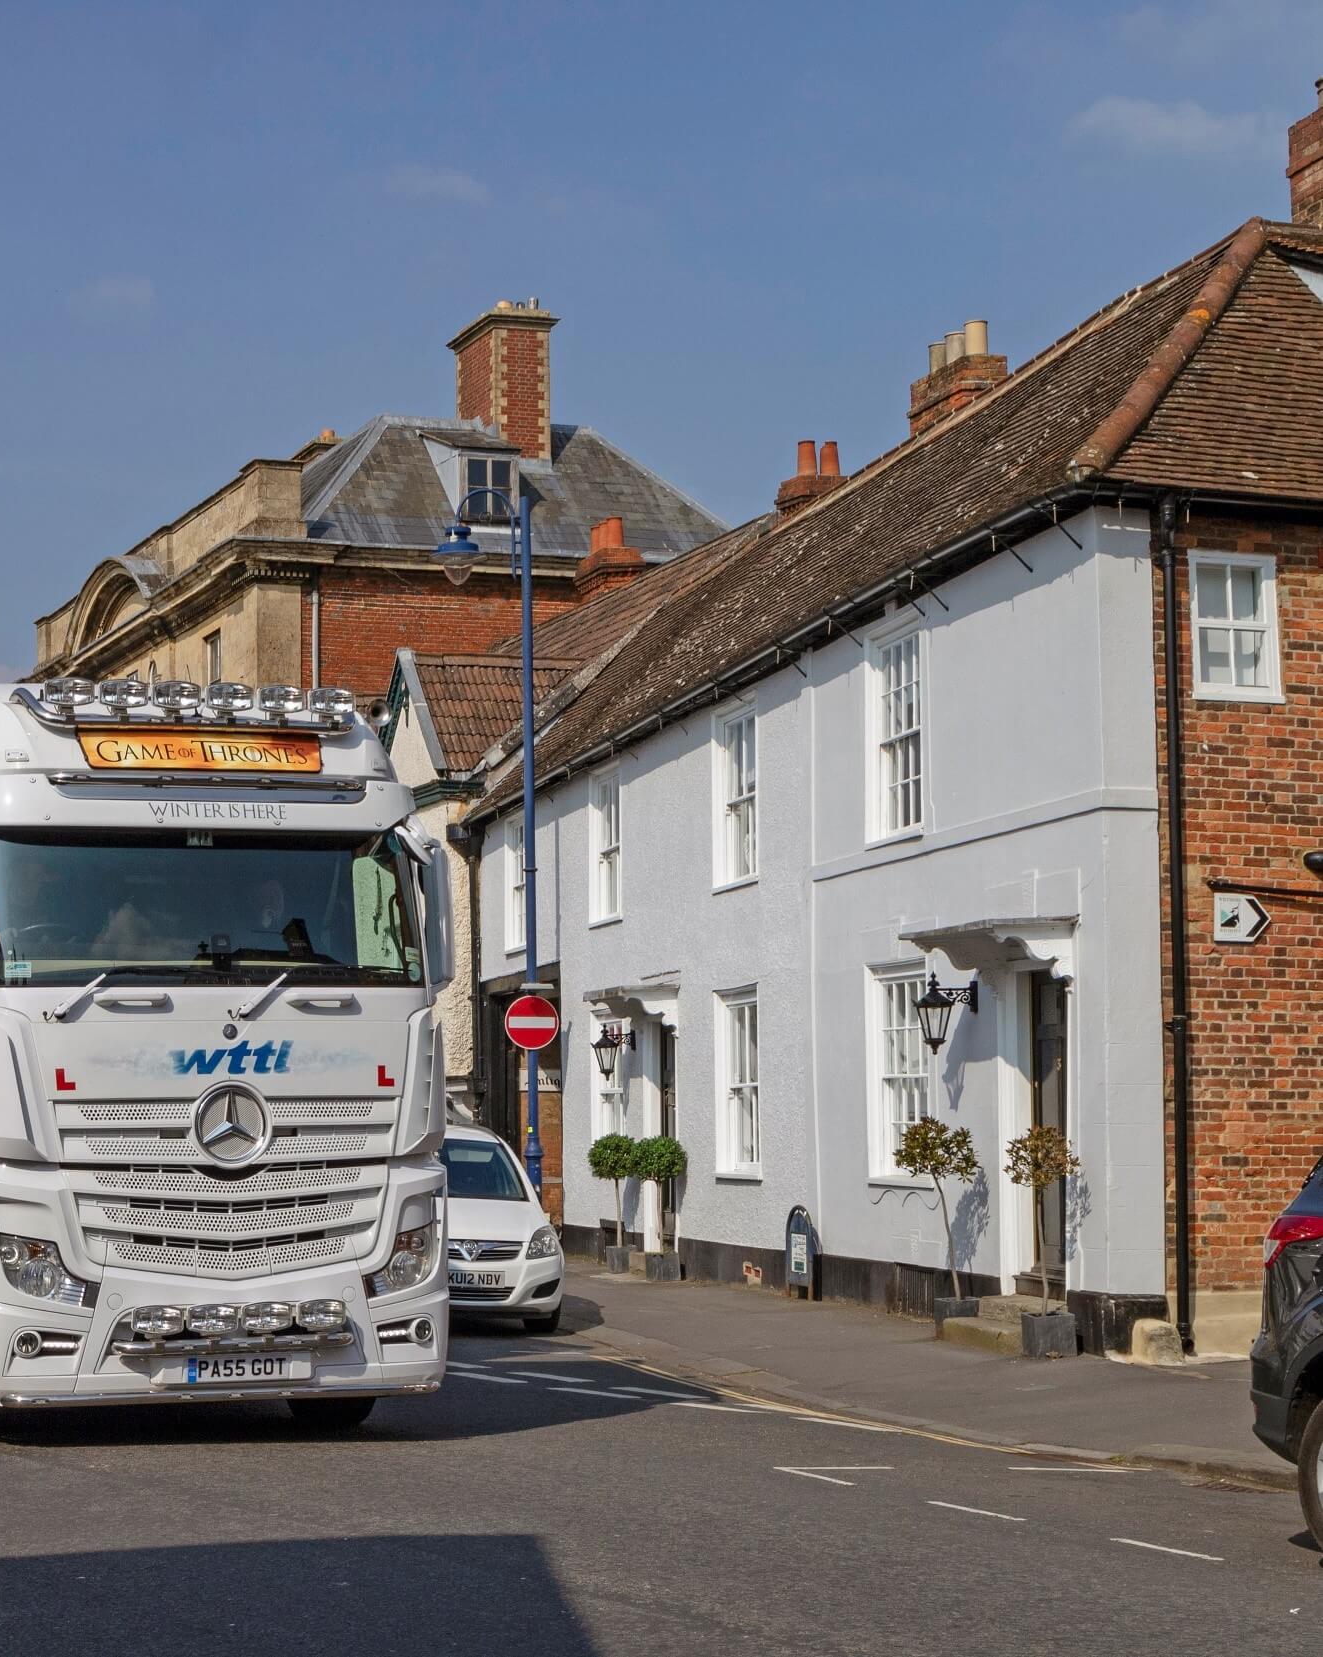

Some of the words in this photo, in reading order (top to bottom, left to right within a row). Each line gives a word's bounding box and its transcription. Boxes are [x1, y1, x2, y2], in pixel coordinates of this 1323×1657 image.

[96, 739, 176, 764] GAME
[178, 746, 196, 758] OF
[191, 739, 308, 766] THRONES
[148, 802, 226, 818] WINTER
[169, 1039, 295, 1075] wttl
[55, 1068, 76, 1091] L
[377, 1065, 395, 1087] L
[447, 1272, 475, 1285] KU12
[198, 1359, 245, 1378] PA55
[251, 1357, 287, 1376] GOT
